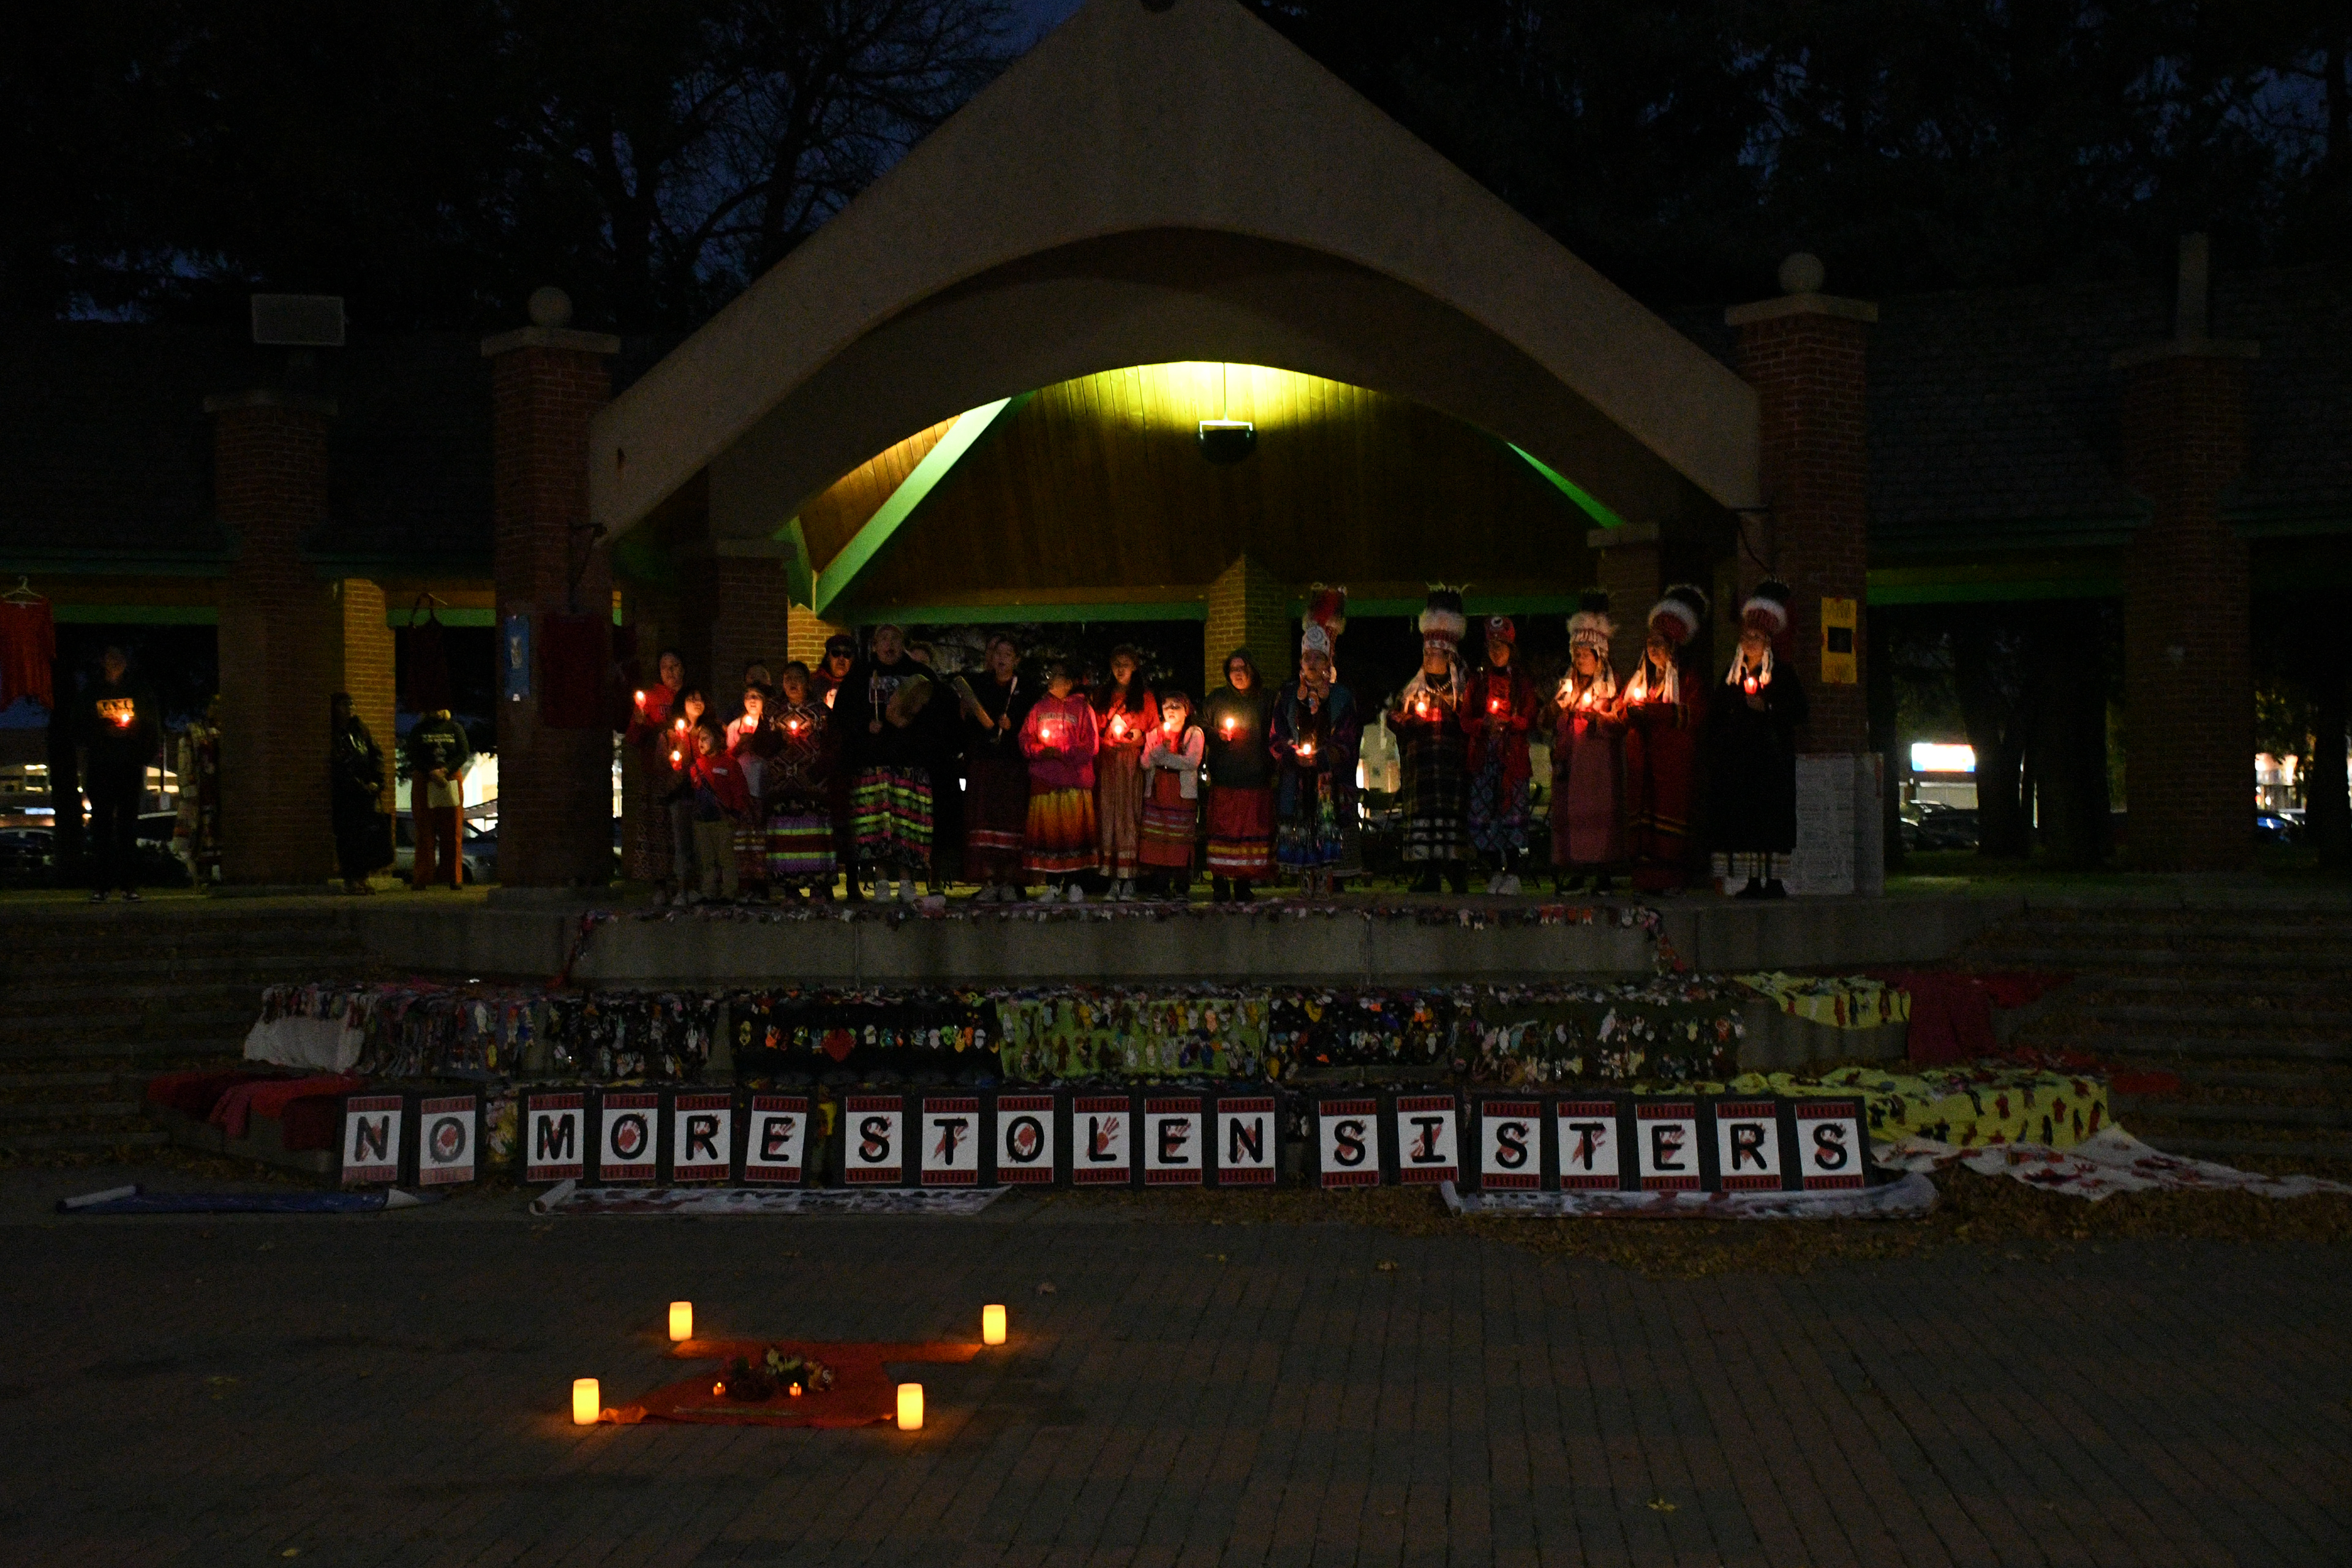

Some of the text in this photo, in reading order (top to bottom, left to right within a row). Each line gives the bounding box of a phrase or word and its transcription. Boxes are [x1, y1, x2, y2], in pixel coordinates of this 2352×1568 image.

[355, 1114, 1848, 1171] NO MORE STOLEN SISTERS
